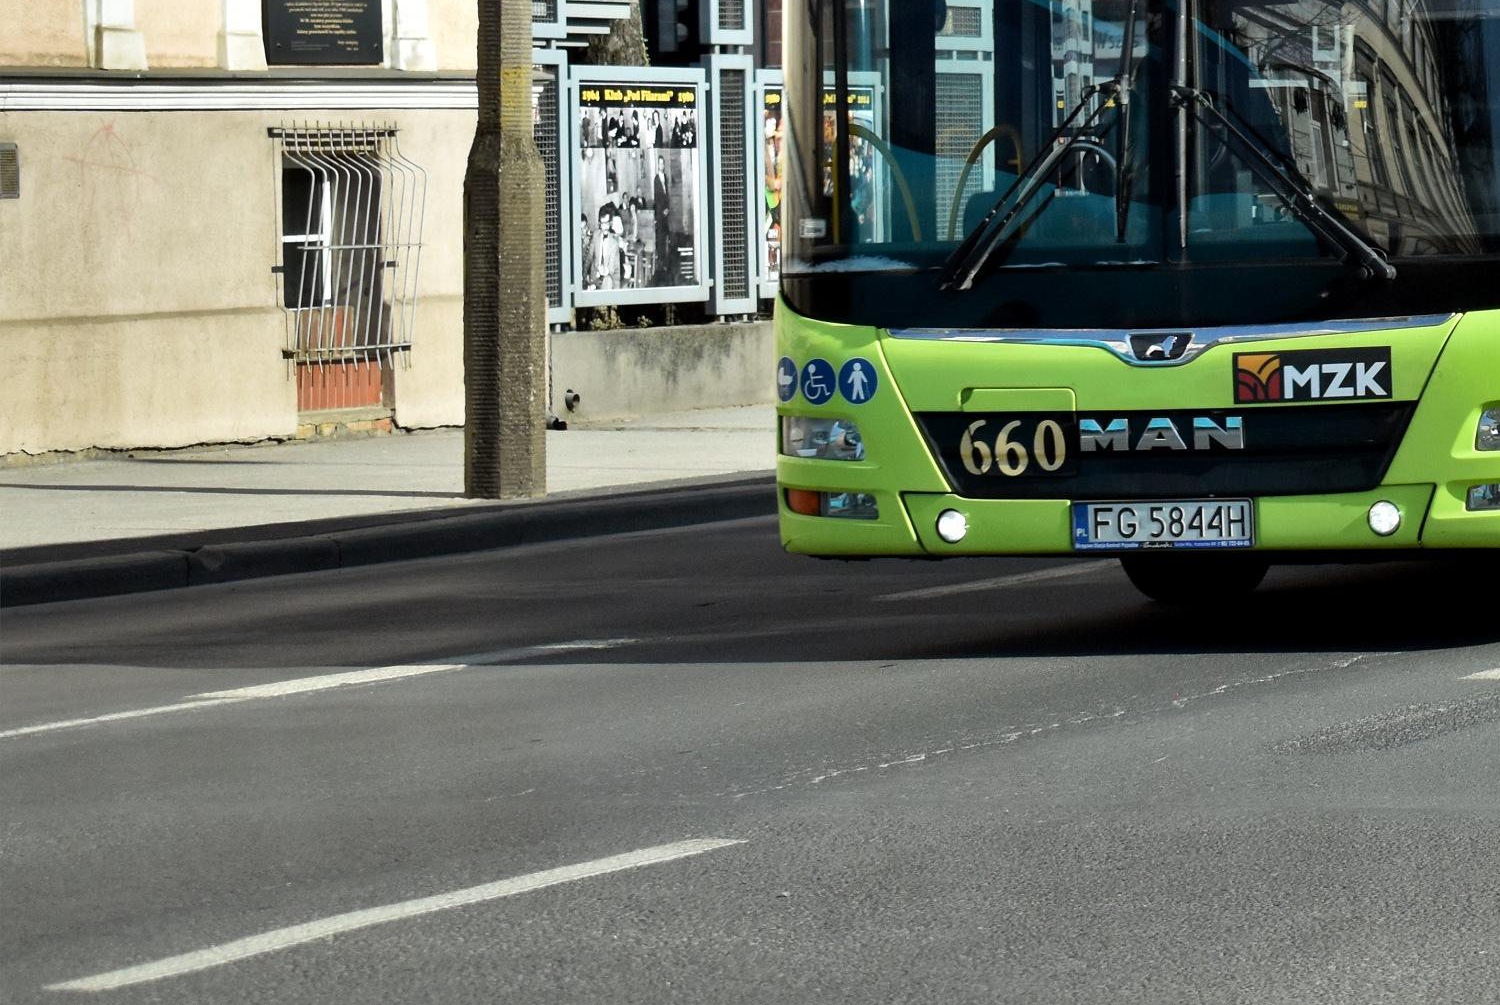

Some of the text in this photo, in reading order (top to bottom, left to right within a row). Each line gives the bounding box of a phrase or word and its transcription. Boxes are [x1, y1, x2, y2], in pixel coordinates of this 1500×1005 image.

[604, 89, 623, 101] Klub
[1284, 361, 1388, 399] MZK
[960, 416, 1245, 477] 660 MAN
[1076, 527, 1088, 538] PL
[1094, 505, 1246, 539] FG 5844H
